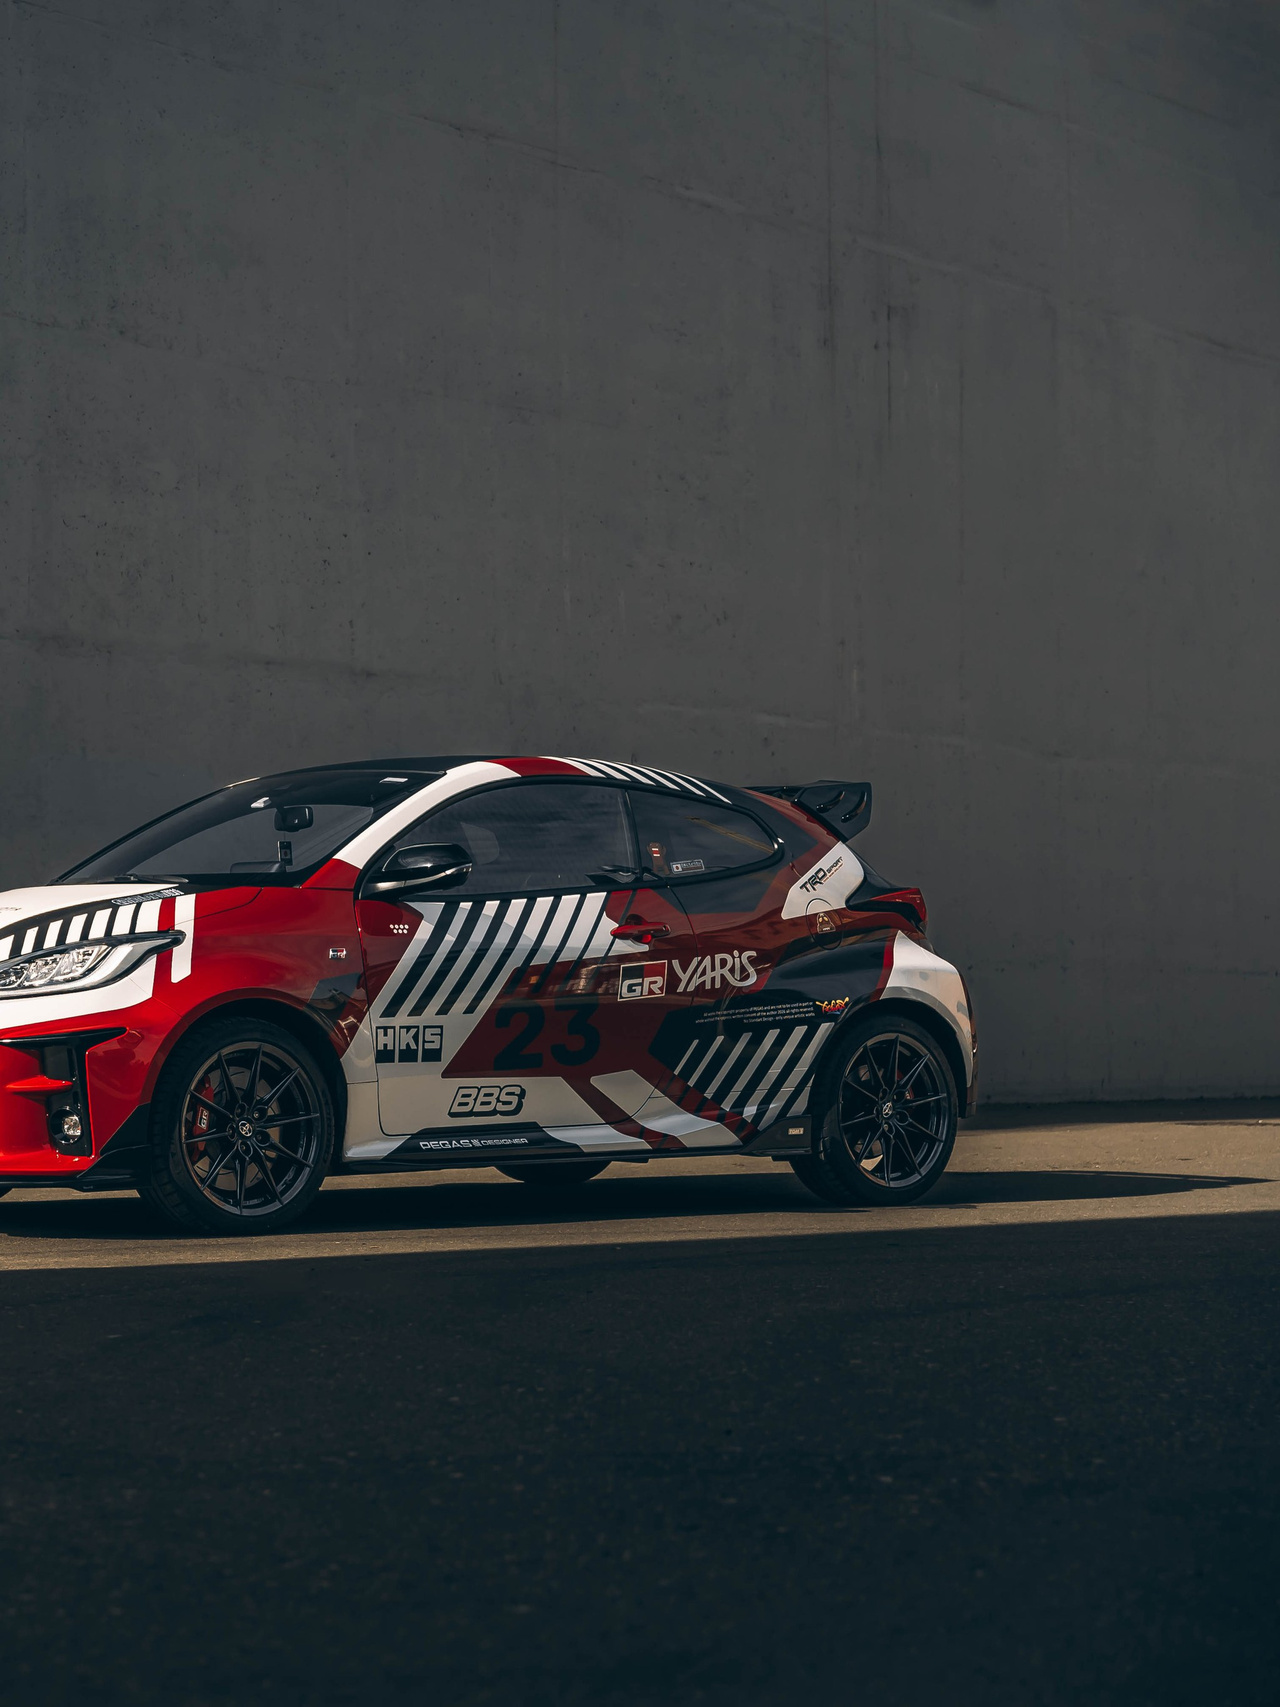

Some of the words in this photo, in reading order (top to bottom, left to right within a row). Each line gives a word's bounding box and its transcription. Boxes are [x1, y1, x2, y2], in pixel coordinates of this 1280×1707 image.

[799, 867, 826, 893] TRD
[622, 976, 664, 998] GR
[376, 1025, 443, 1054] HKS
[493, 993, 601, 1071] 23
[448, 1084, 526, 1118] BBS
[419, 1139, 472, 1150] PEGAS
[481, 1138, 529, 1146] DESIGNER
